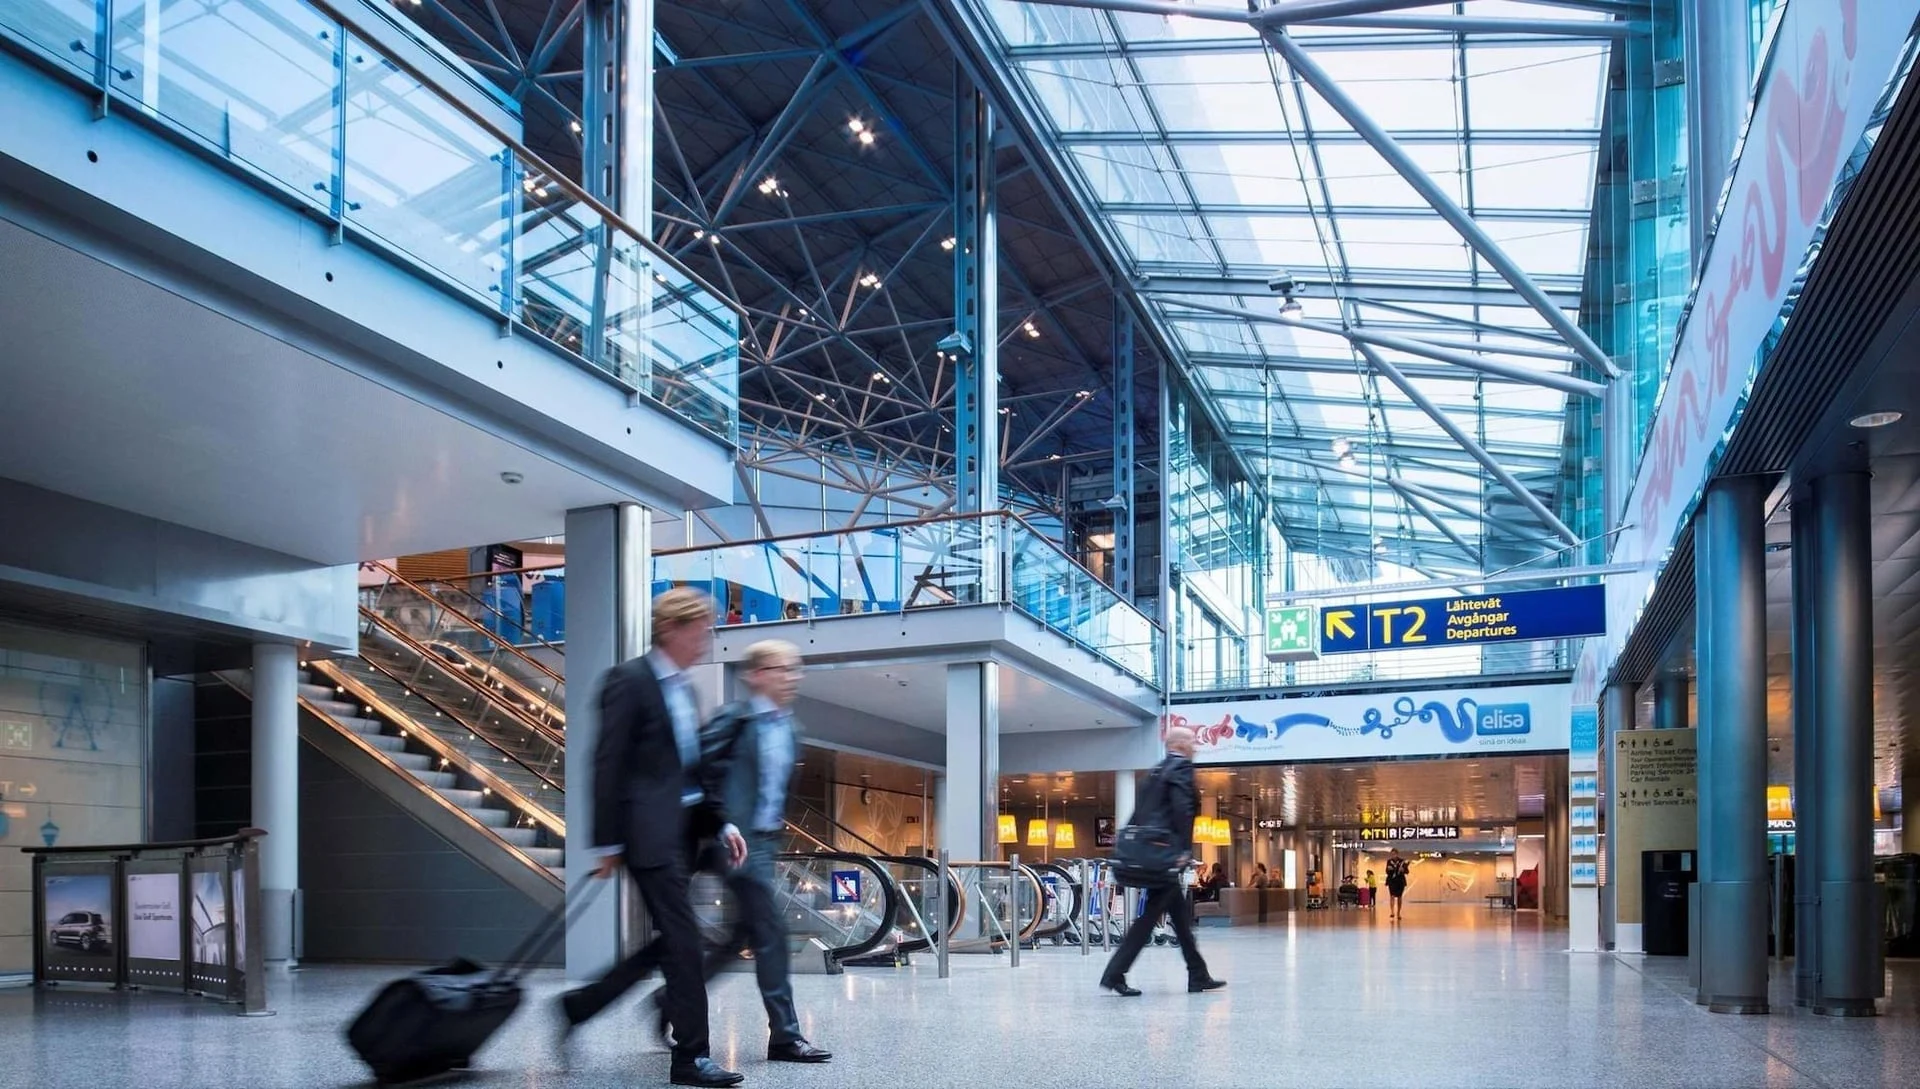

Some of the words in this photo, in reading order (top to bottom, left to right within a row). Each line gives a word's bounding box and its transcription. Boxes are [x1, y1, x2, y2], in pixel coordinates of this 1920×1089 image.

[1446, 597, 1501, 612] Lähtevät
[1373, 606, 1427, 644] T2
[1447, 611, 1509, 627] Avgångar
[1446, 624, 1517, 640] Departures
[1482, 708, 1525, 729] elisa
